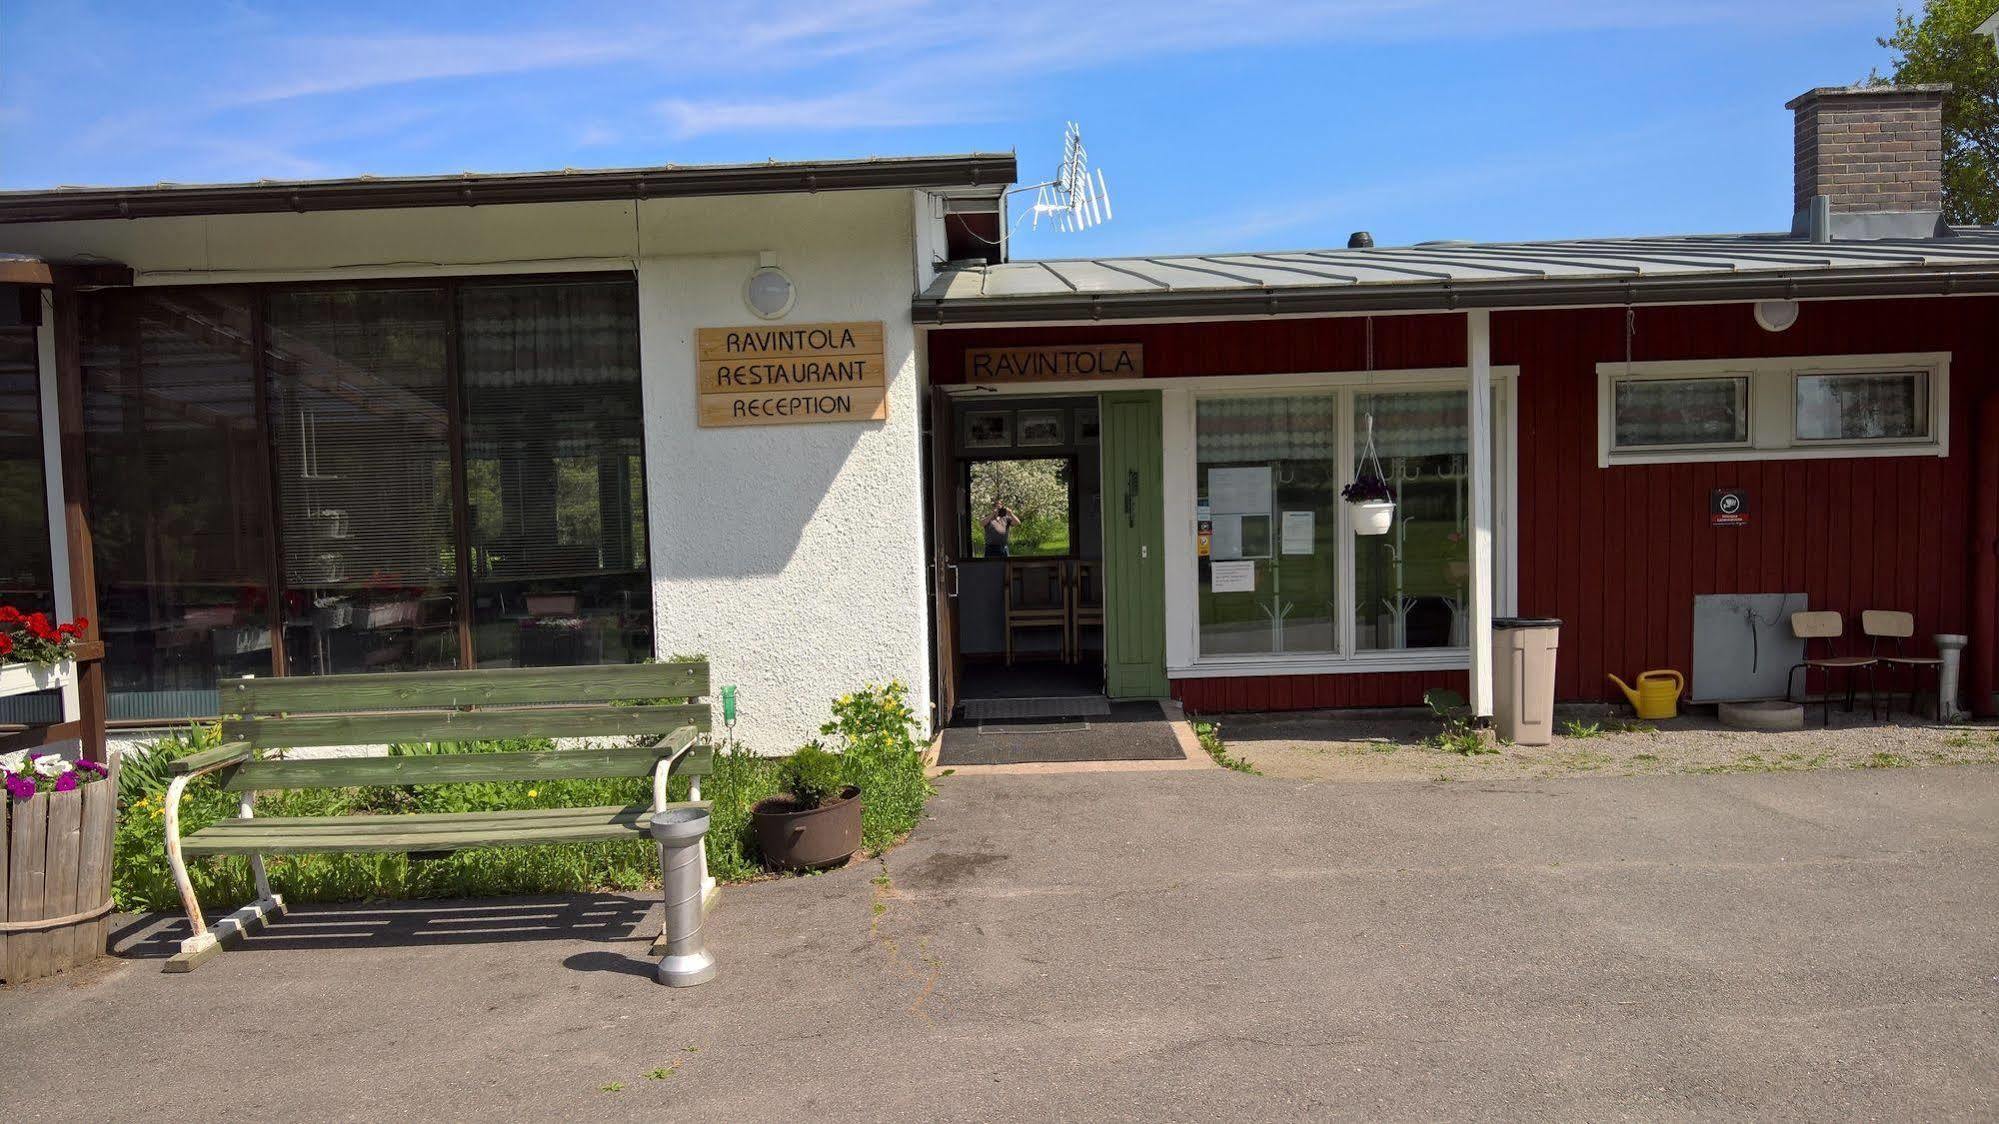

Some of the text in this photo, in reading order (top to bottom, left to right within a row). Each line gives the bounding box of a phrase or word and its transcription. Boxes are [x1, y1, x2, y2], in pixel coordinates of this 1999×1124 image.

[727, 328, 855, 353] RAVINTOLA
[717, 361, 866, 386] RESTAURANT
[974, 350, 1135, 378] RAVINTOLA
[733, 396, 851, 417] RECEPTION
